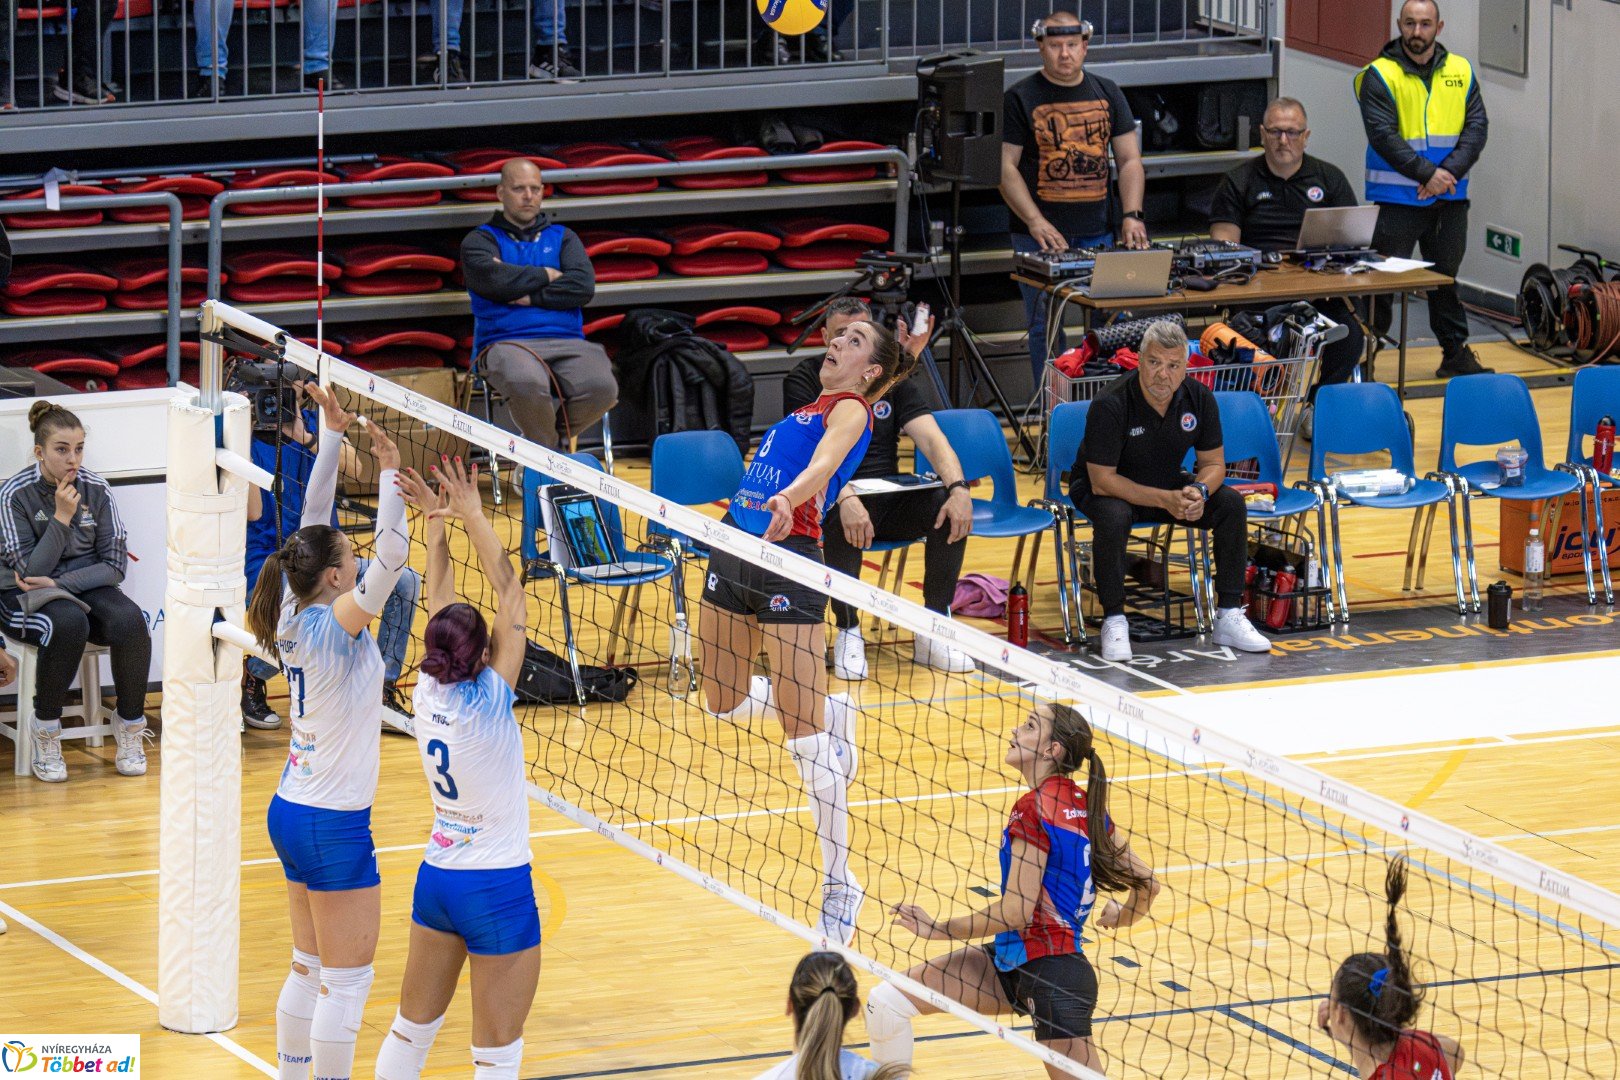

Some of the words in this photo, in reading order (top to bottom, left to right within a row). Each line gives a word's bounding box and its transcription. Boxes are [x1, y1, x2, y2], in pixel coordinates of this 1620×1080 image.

[758, 429, 777, 458] 8
[746, 461, 782, 485] TUM
[707, 572, 719, 592] 8
[427, 738, 459, 801] 3
